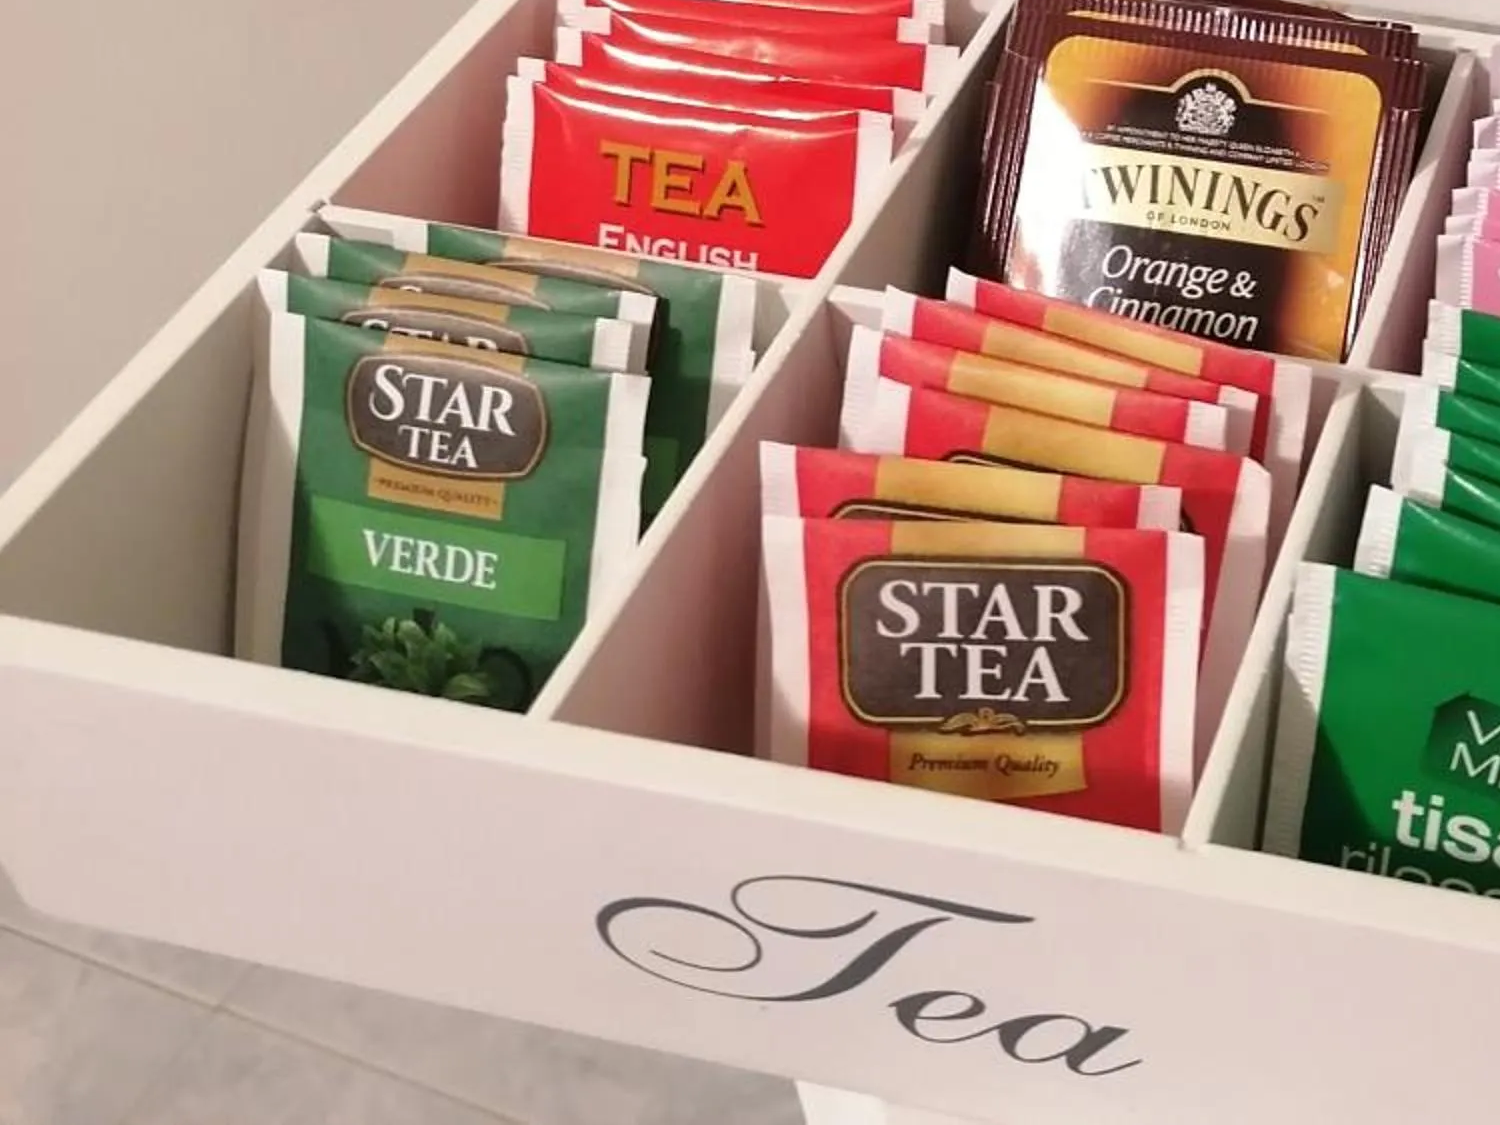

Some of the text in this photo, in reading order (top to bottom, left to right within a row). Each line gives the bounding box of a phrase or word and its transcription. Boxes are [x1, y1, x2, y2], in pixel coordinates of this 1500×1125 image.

[601, 141, 764, 228] TEA
[598, 222, 759, 272] ENGLISH
[1146, 210, 1232, 232] OF LONDON
[1102, 244, 1258, 299] Orange &
[1087, 285, 1259, 342] Cinnamon
[368, 363, 517, 438] STAR
[400, 424, 479, 470] TEA
[362, 527, 499, 591] VERDE
[876, 579, 1090, 643] STAR
[900, 642, 1071, 704] TEA
[907, 751, 1061, 778] Premium Quality
[595, 874, 1143, 1077] Tea
